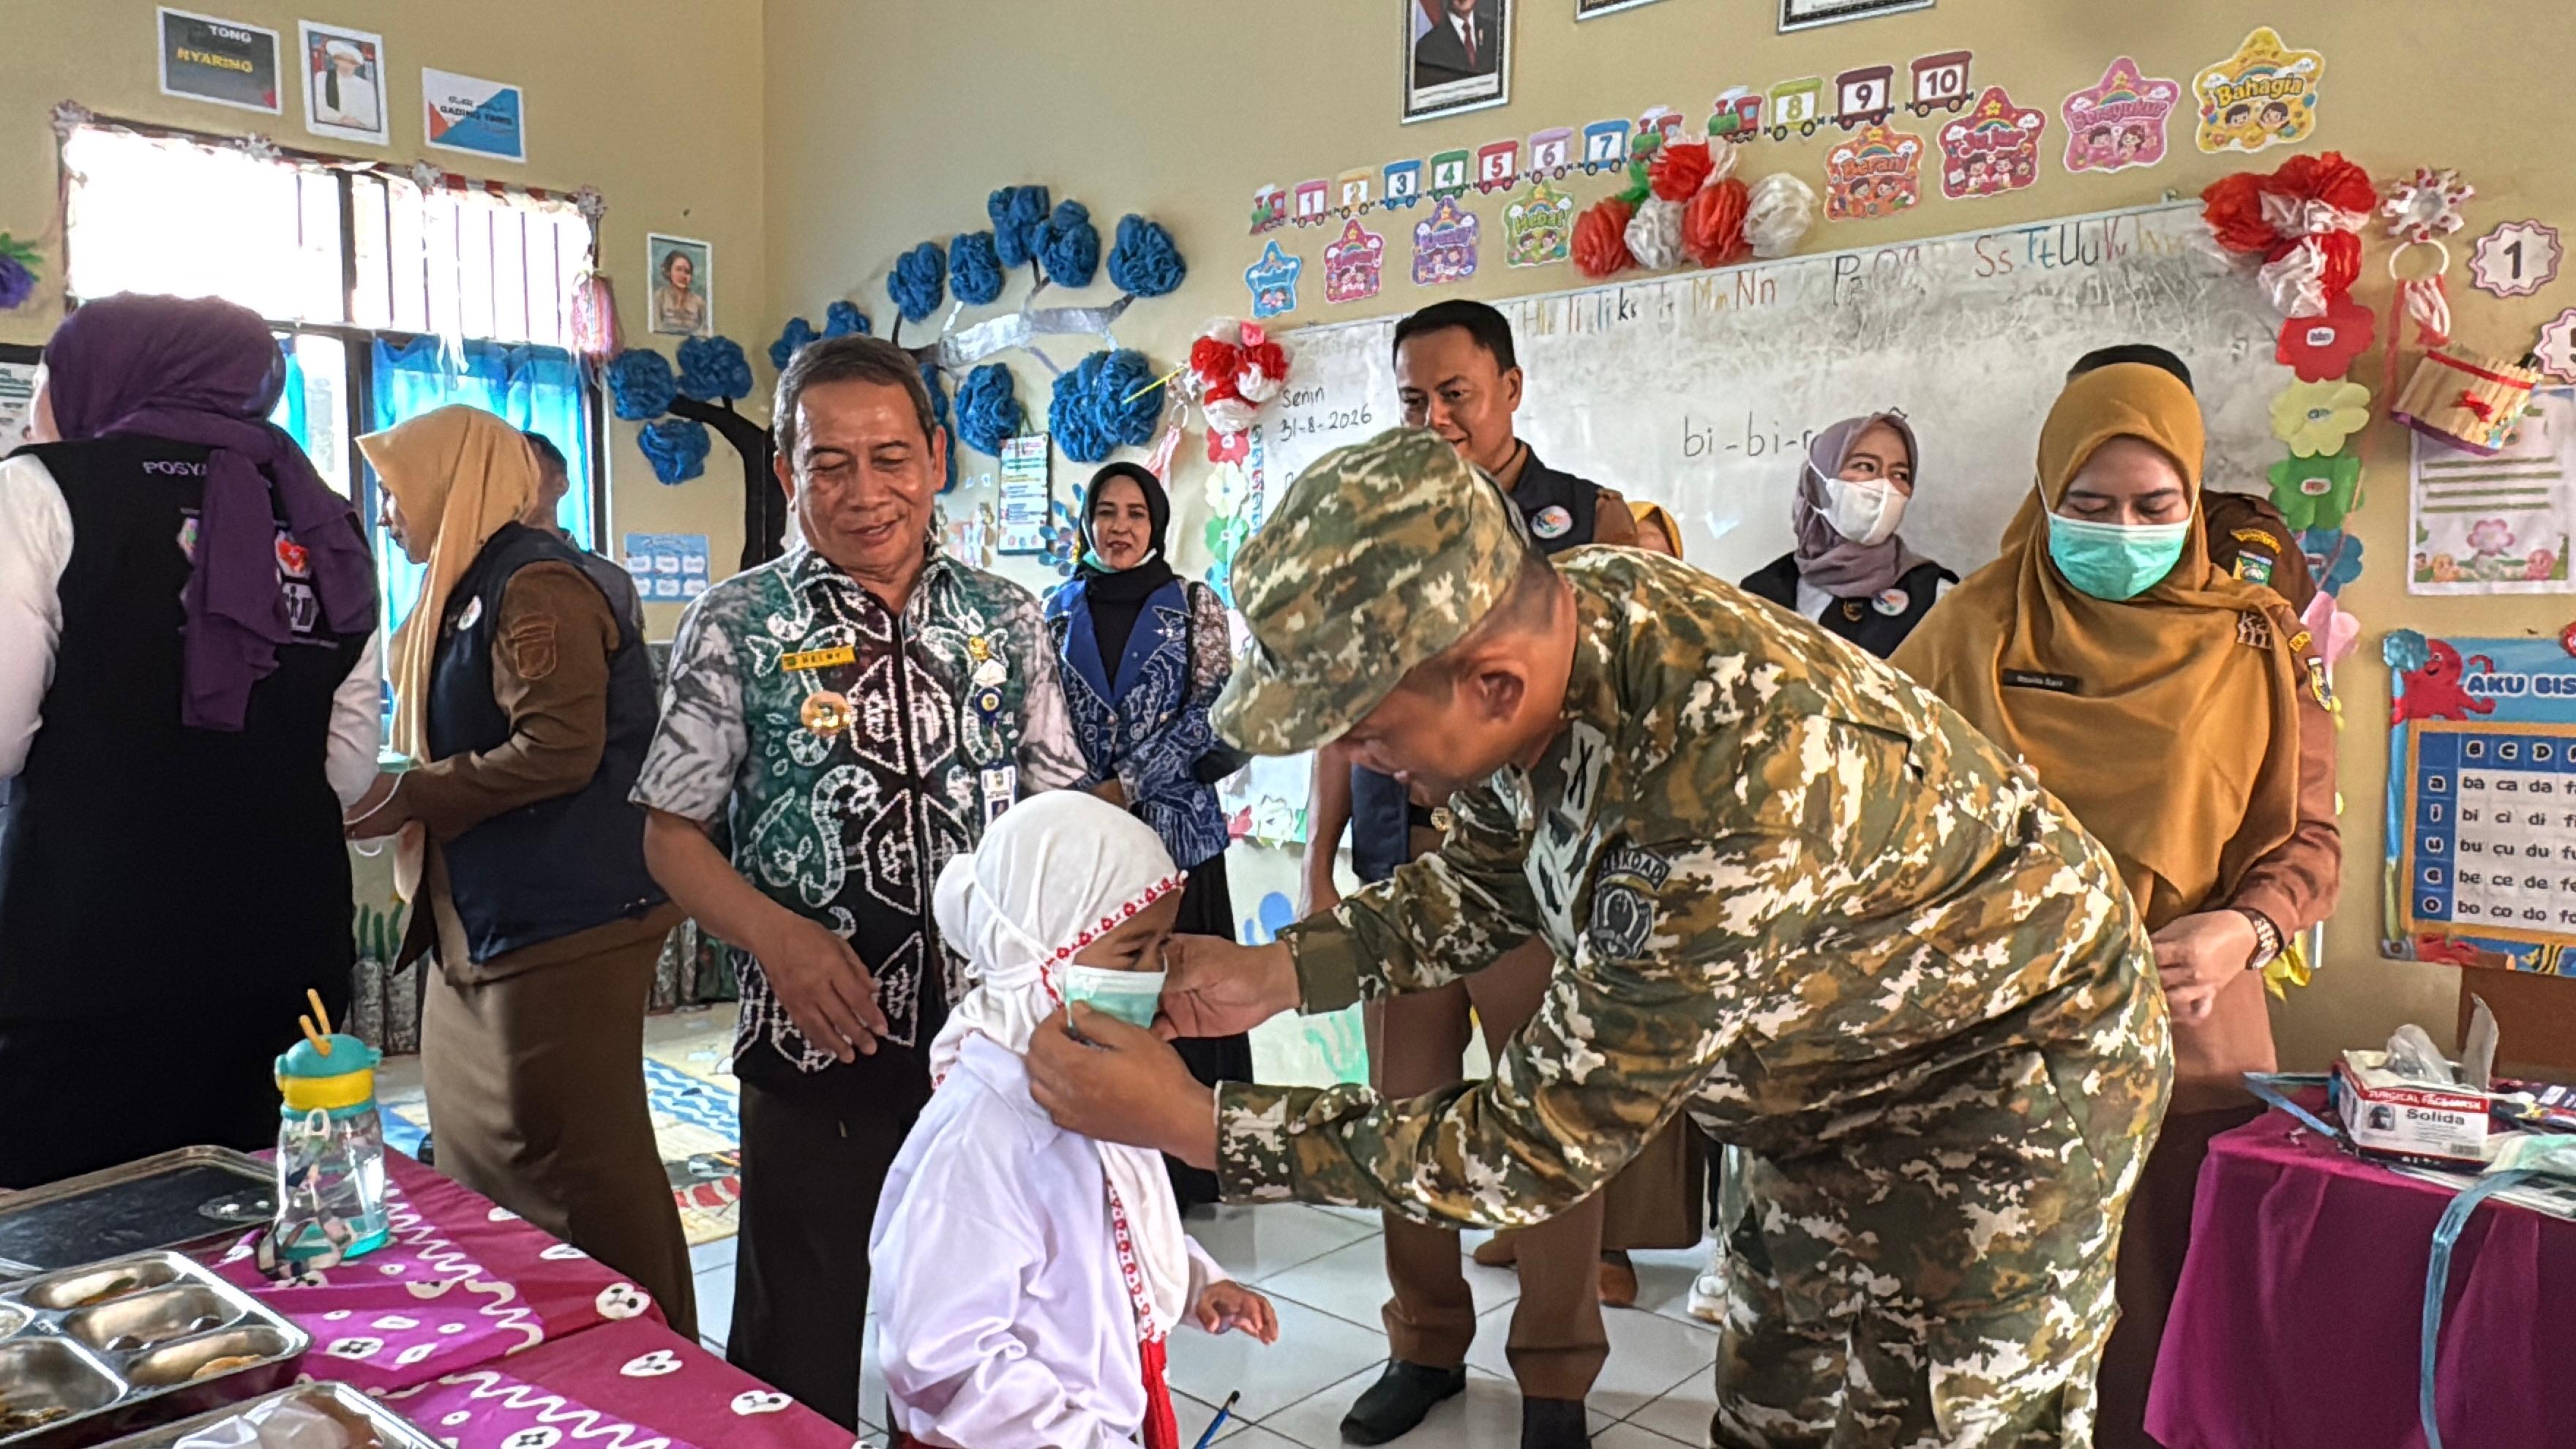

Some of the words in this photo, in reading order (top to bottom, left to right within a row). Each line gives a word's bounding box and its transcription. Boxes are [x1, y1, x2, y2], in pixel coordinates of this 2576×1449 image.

[209, 25, 251, 42] TONG
[1926, 69, 1957, 96] 10
[2214, 73, 2303, 108] Bahagia
[1856, 84, 1871, 109] 9
[1788, 95, 1802, 120] 8
[1543, 145, 1556, 165] 6
[1600, 135, 1613, 158] 7
[1442, 168, 1455, 184] 4
[1491, 156, 1504, 176] 5
[1396, 174, 1408, 194] 3
[1306, 192, 1314, 215] 1
[2504, 241, 2521, 279] 1
[1282, 386, 1325, 408] Senin
[2466, 674, 2526, 694] AKU
[2501, 744, 2516, 757] C
[2536, 745, 2550, 758] D
[2430, 777, 2443, 789] a
[2463, 776, 2485, 790] ba
[2496, 779, 2517, 792] ca
[2529, 779, 2552, 793] da
[2463, 808, 2479, 821] bi
[2495, 811, 2512, 824] ci
[2528, 812, 2546, 825] di
[2428, 839, 2441, 850] u
[2460, 839, 2482, 853] bu
[2493, 844, 2515, 855] cu
[2526, 844, 2550, 858] du
[2459, 869, 2480, 884] be
[2492, 875, 2513, 886] ce
[2525, 876, 2548, 889] de
[2425, 899, 2438, 911] o
[2457, 901, 2480, 914] bo
[2490, 905, 2512, 917] co
[2523, 907, 2546, 921] do
[2406, 1109, 2465, 1125] Solida
